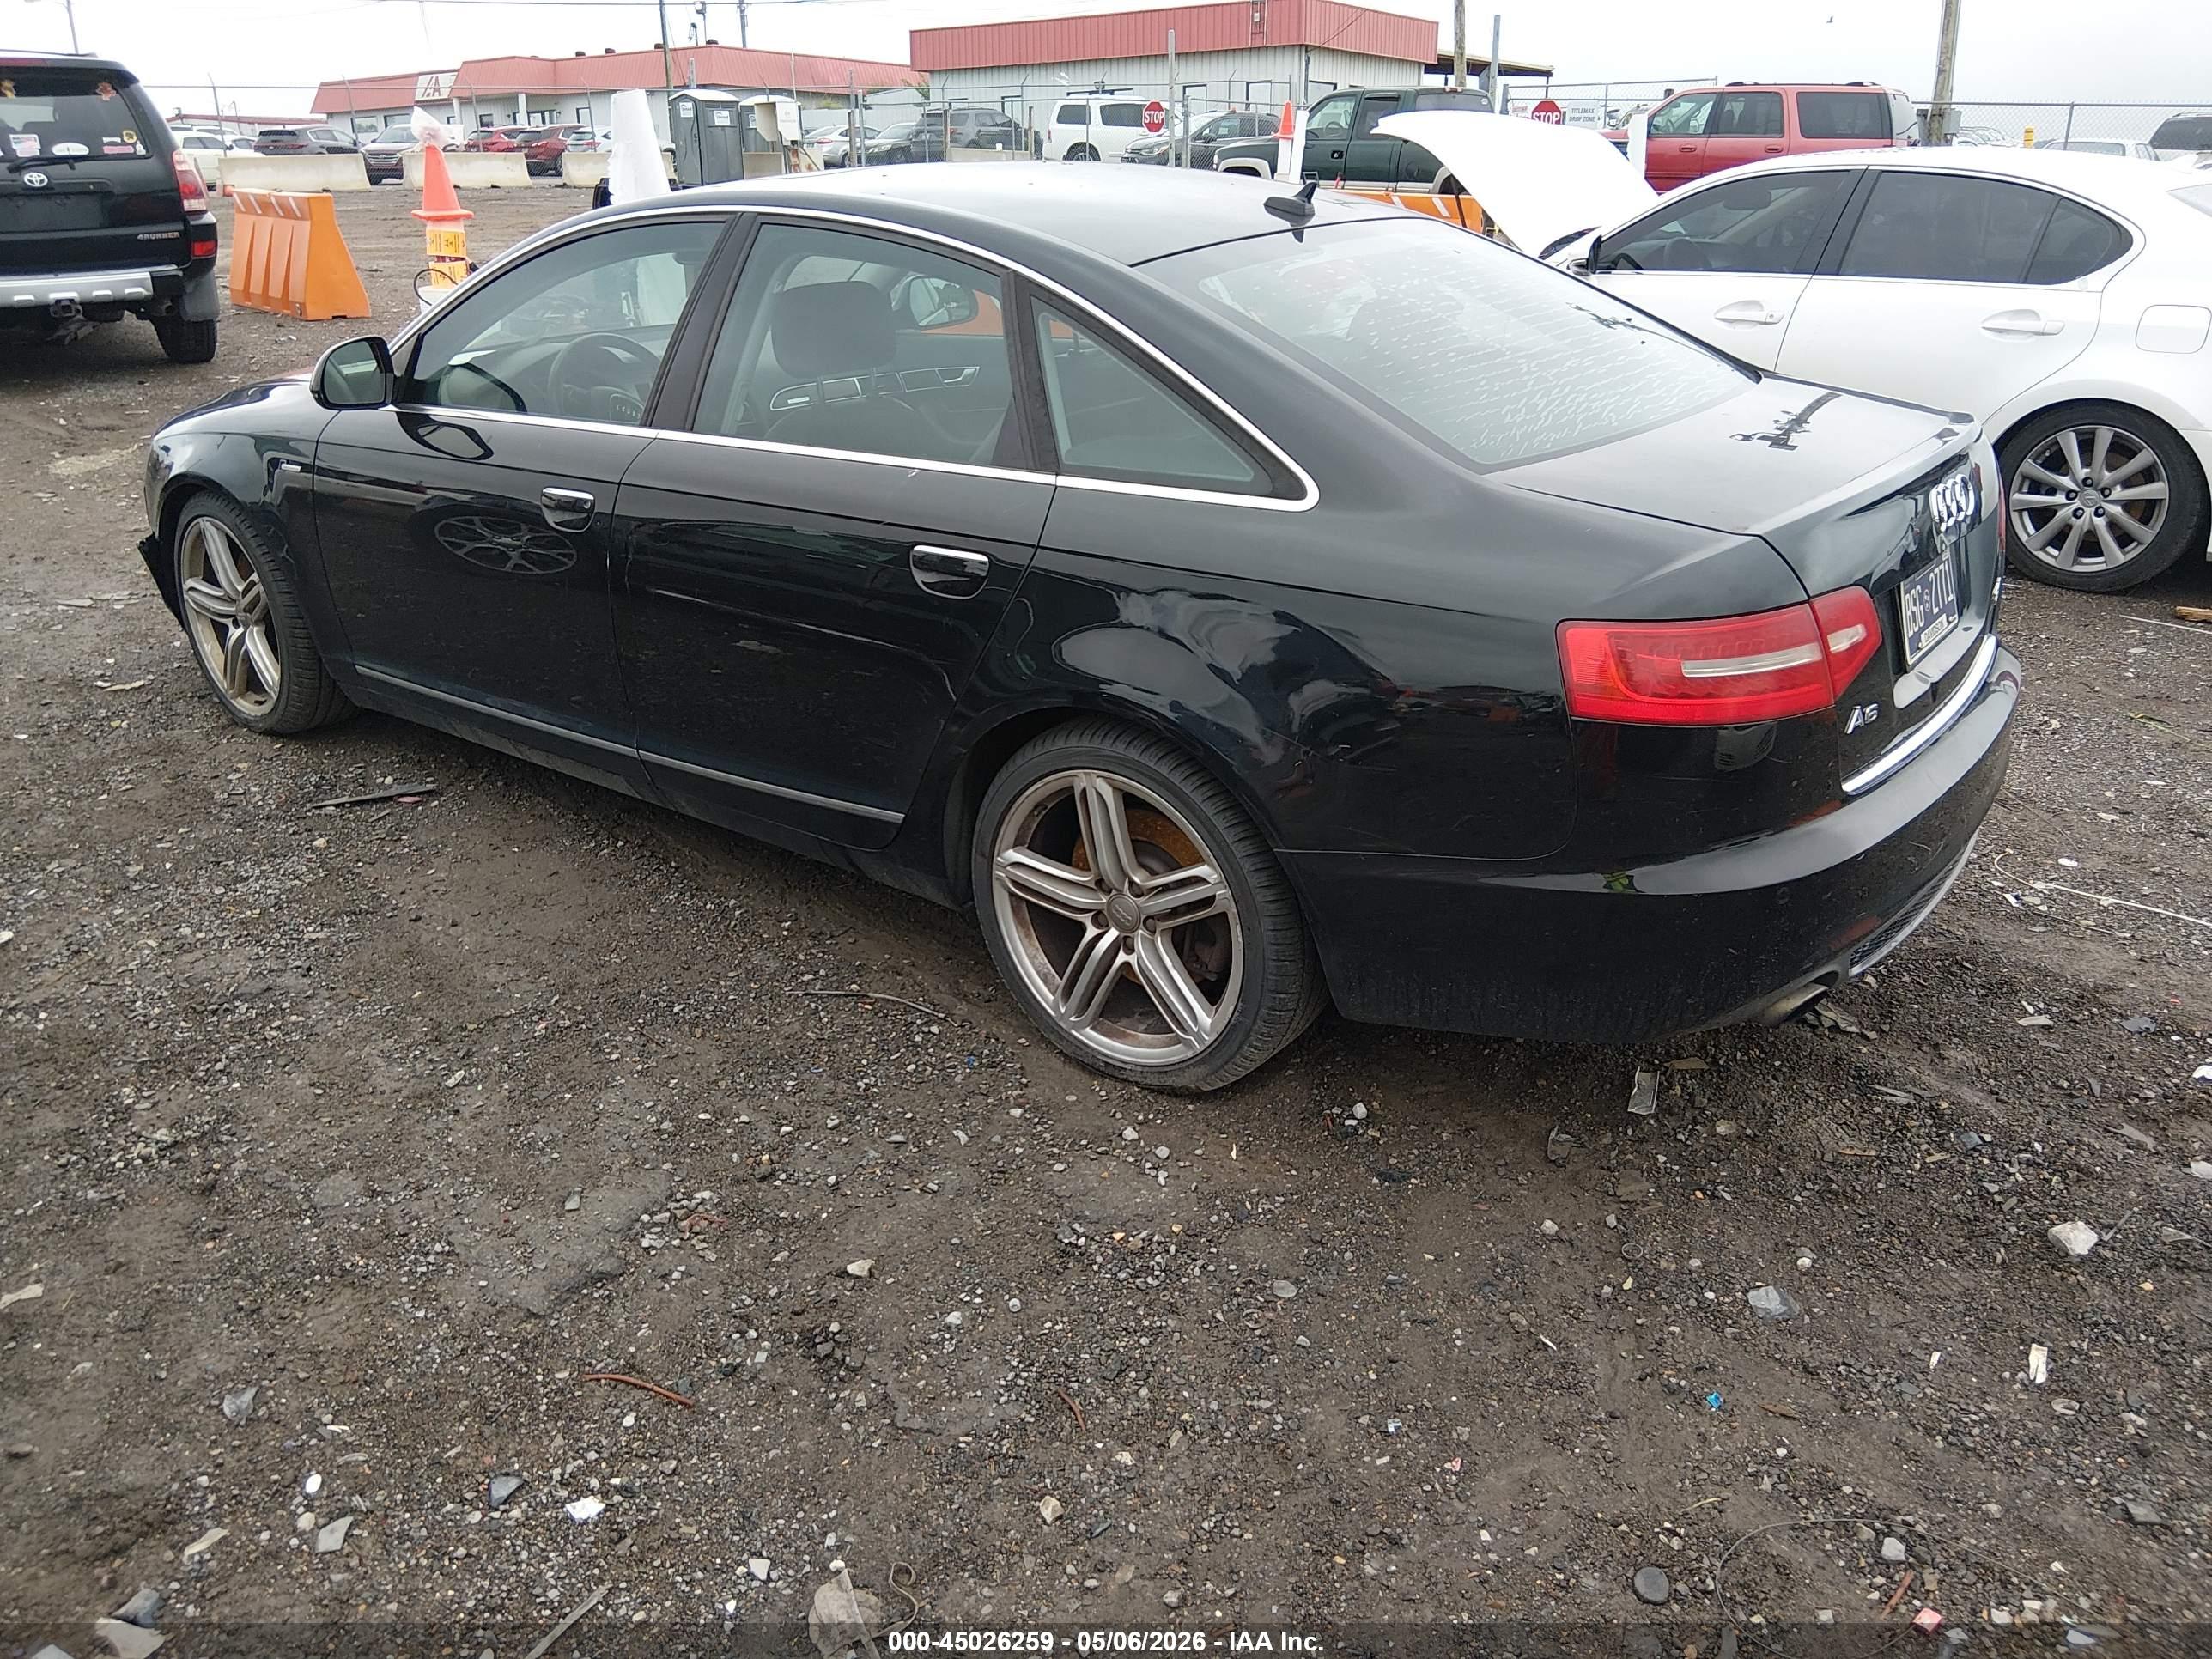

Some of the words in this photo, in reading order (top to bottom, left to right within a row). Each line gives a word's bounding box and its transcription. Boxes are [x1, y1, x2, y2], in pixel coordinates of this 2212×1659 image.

[1144, 111, 1164, 124] STOP
[1533, 112, 1561, 125] STOP
[1905, 584, 1925, 638] BSG
[1929, 560, 1954, 615] 2771
[1844, 703, 1879, 734] A6
